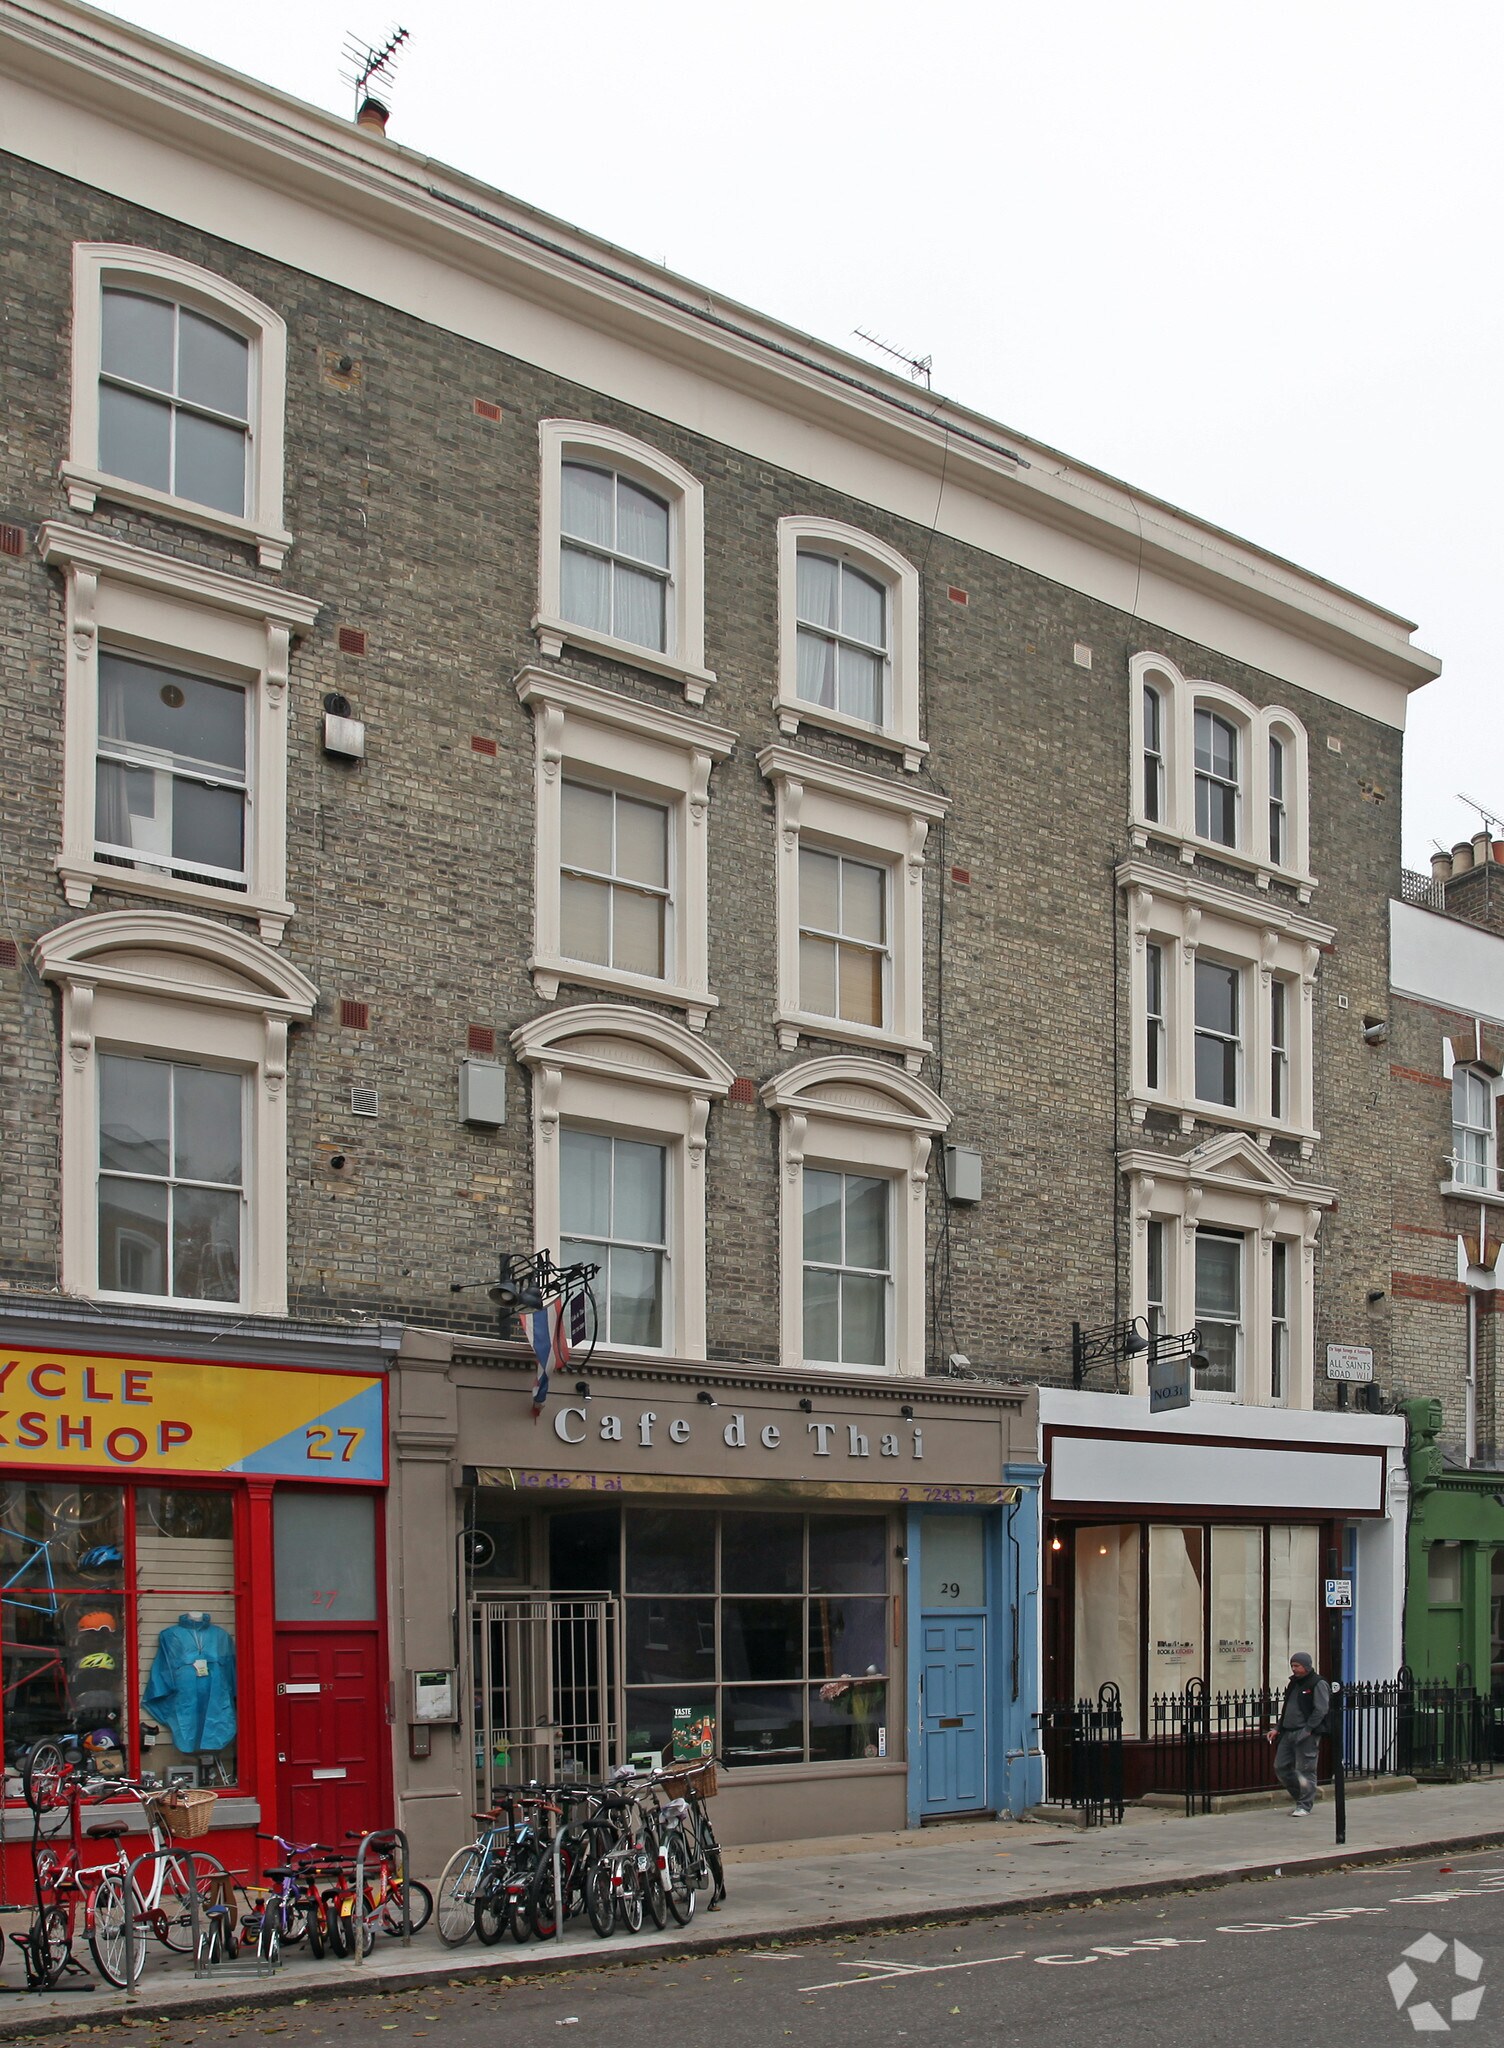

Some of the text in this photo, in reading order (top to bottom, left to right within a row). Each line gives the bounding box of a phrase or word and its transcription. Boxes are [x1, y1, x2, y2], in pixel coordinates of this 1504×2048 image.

[1329, 1360, 1371, 1370] ALL SAINTS
[554, 1407, 924, 1459] Cafe de Thai
[306, 1425, 366, 1462] 27
[311, 1590, 337, 1610] 27
[940, 1582, 960, 1599] 29
[278, 1684, 285, 1695] B
[1034, 1938, 1206, 1965] CAR
[1216, 1907, 1388, 1933] CLUB
